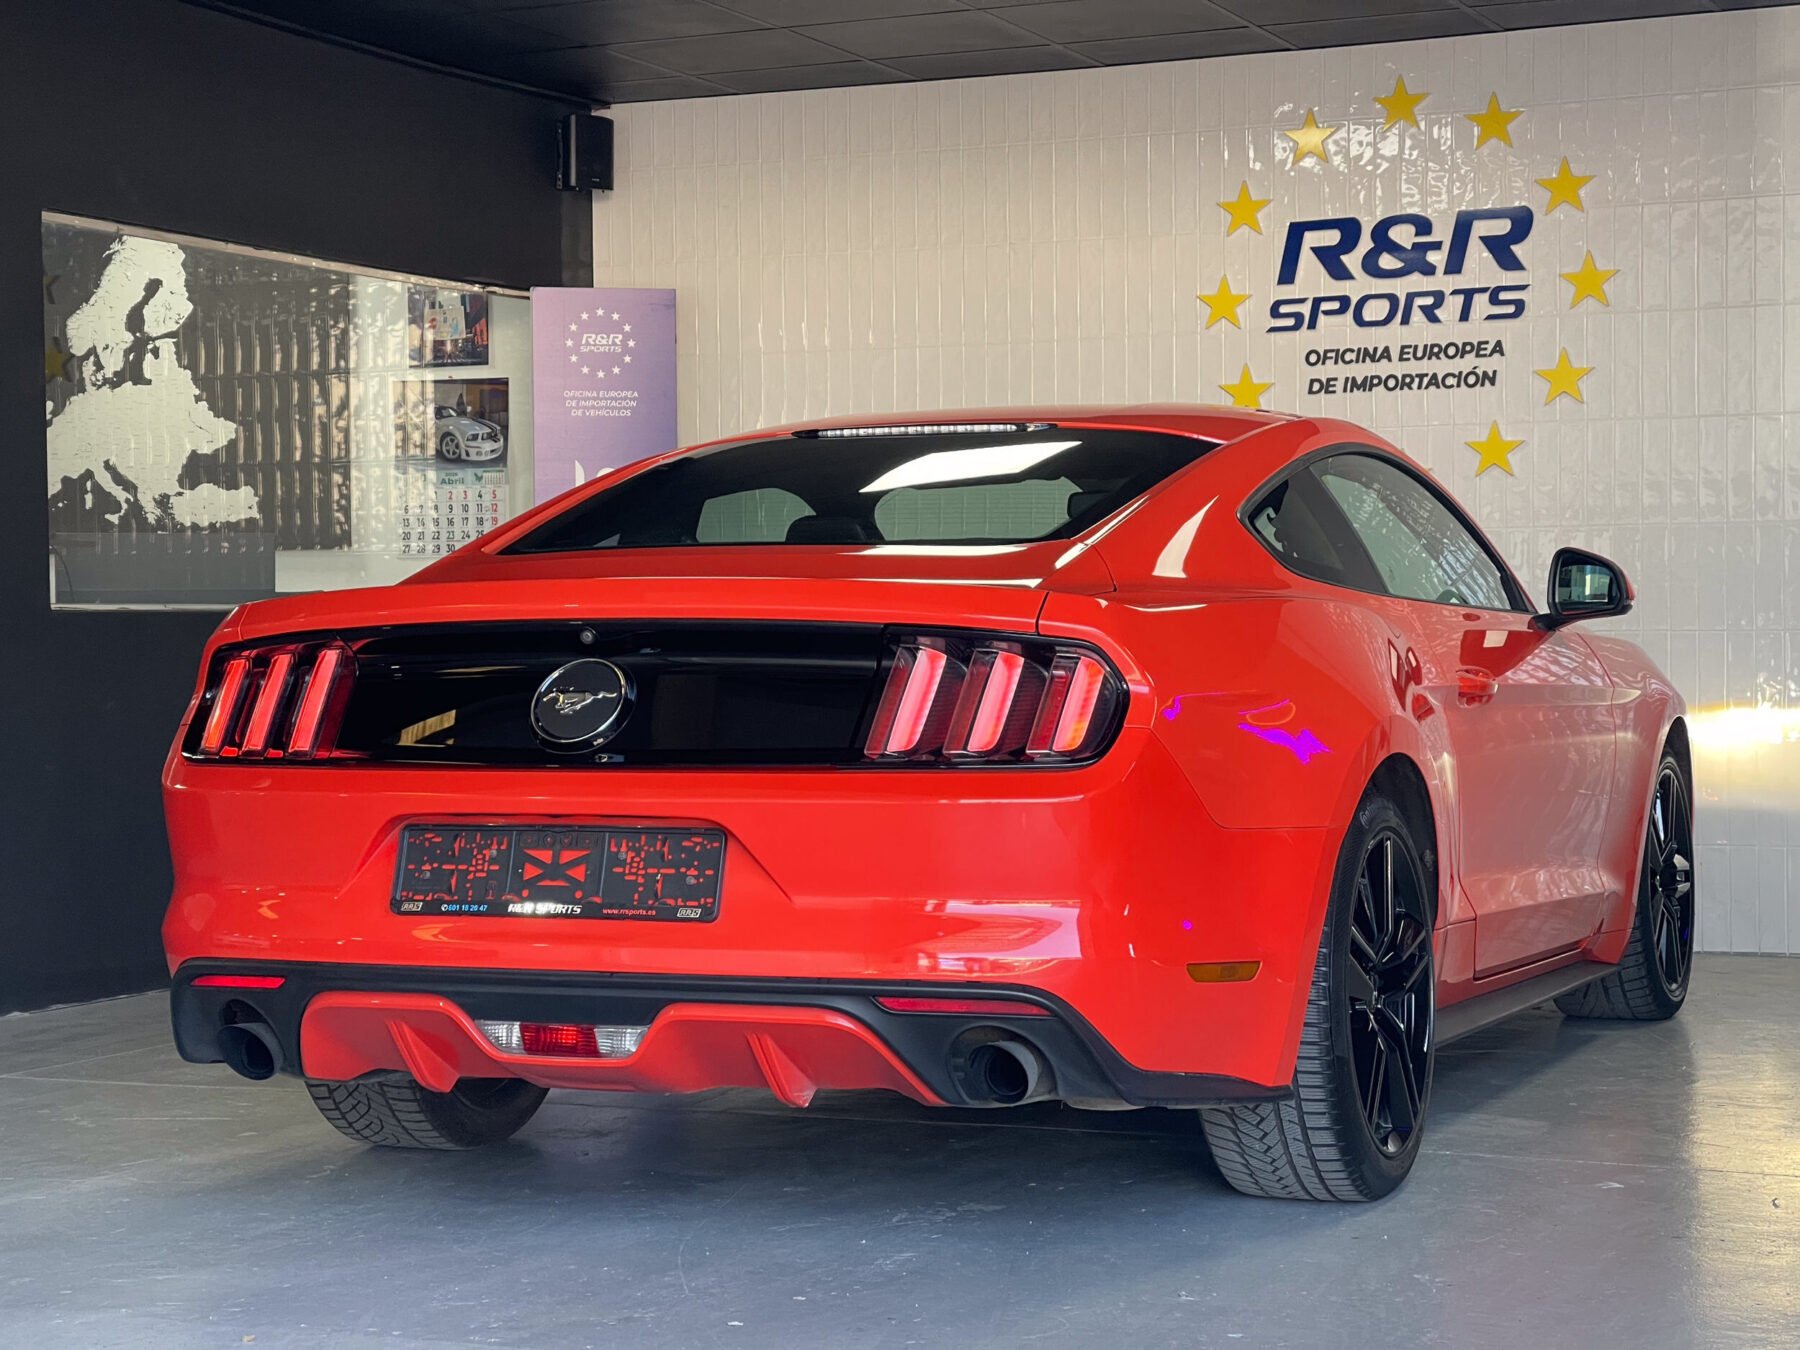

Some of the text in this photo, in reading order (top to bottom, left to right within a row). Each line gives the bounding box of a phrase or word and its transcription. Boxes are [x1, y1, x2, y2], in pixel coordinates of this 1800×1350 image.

[1276, 205, 1534, 286] R&R
[1266, 283, 1531, 333] SPORTS
[582, 334, 622, 345] R&R
[1305, 340, 1505, 366] OFICINA EUROPEA
[1308, 365, 1497, 395] DE IMPORTACIÓN
[563, 390, 638, 398] OFICINA EUROPEA
[579, 399, 637, 407] IMPORTACIÓN
[585, 408, 632, 416] VEHÍCULOS
[448, 490, 453, 500] 2
[463, 490, 468, 499] 3
[478, 490, 482, 499] 4
[492, 490, 496, 499] 5
[404, 505, 409, 514] 6
[448, 504, 453, 513] 9
[461, 504, 469, 512] 10
[477, 504, 482, 512] 11
[491, 503, 498, 512] 12
[402, 516, 498, 527] 13 14 15 16 17 18 19
[402, 531, 411, 540] 20
[417, 531, 424, 540] 21
[432, 531, 440, 540] 22
[447, 531, 455, 540] 23
[461, 531, 470, 539] 24
[402, 545, 411, 553] 27
[432, 544, 440, 553] 29
[446, 544, 455, 553] 30
[535, 902, 582, 914] SPORTS
